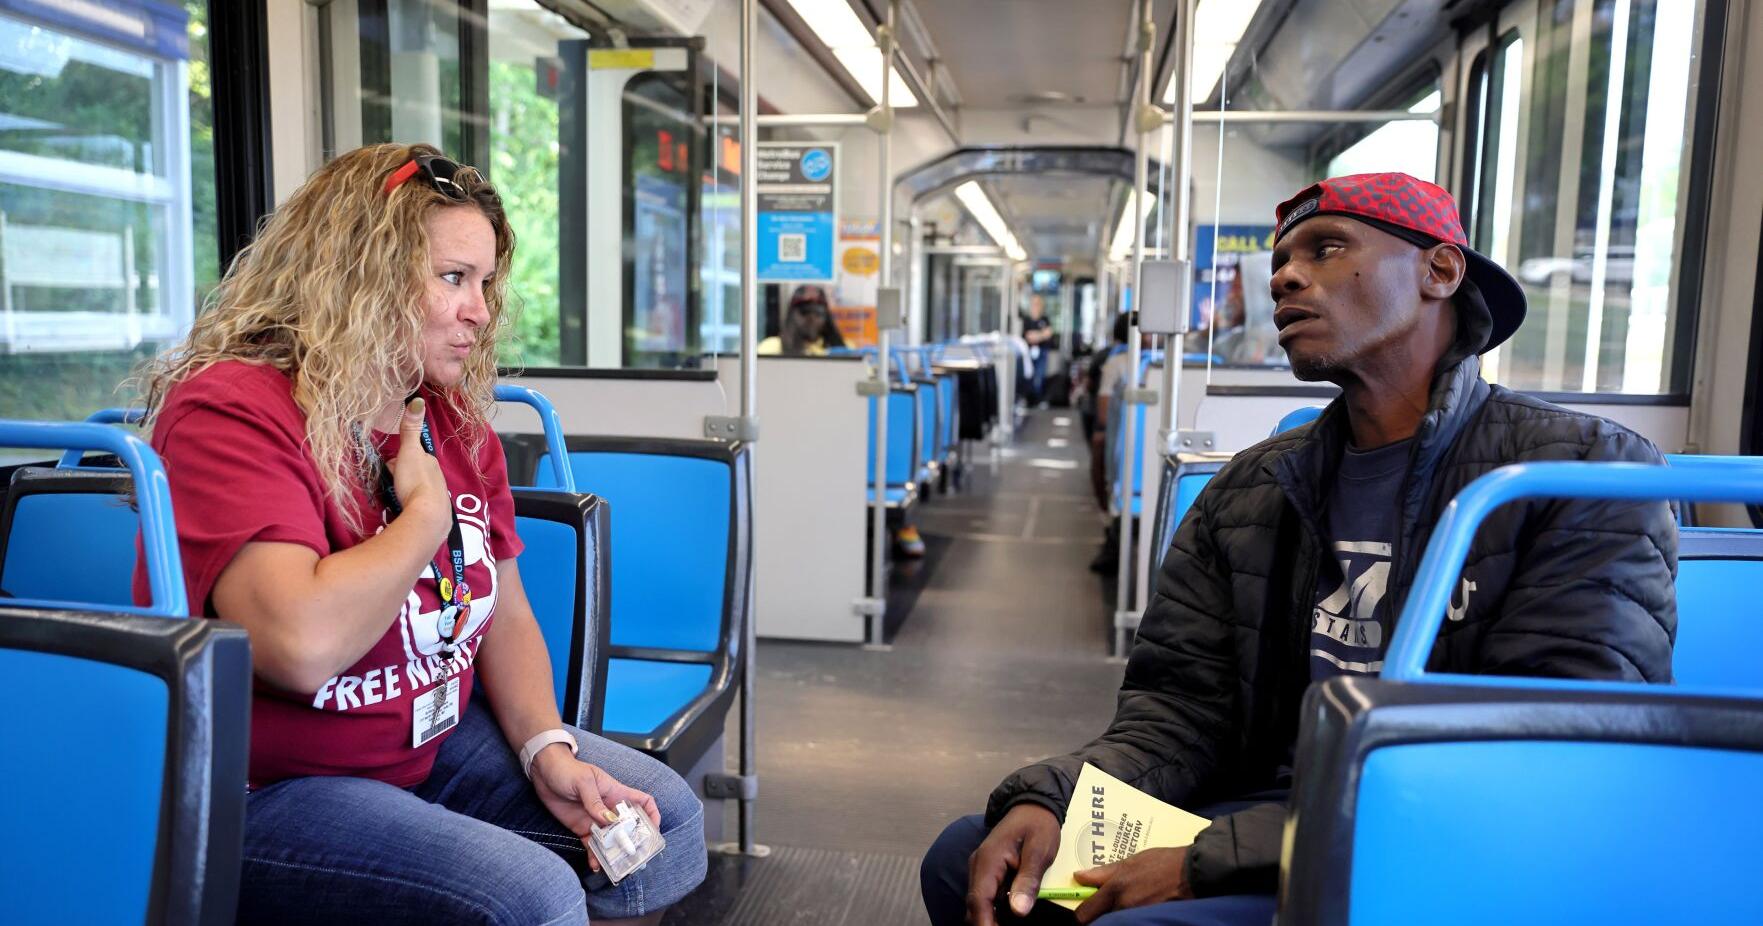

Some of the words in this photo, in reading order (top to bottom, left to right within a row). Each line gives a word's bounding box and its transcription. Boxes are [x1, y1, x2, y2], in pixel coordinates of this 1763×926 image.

[312, 664, 402, 711] FREE
[1092, 785, 1105, 837] HERE
[1112, 831, 1123, 852] LOUIS
[1118, 812, 1128, 831] AREA
